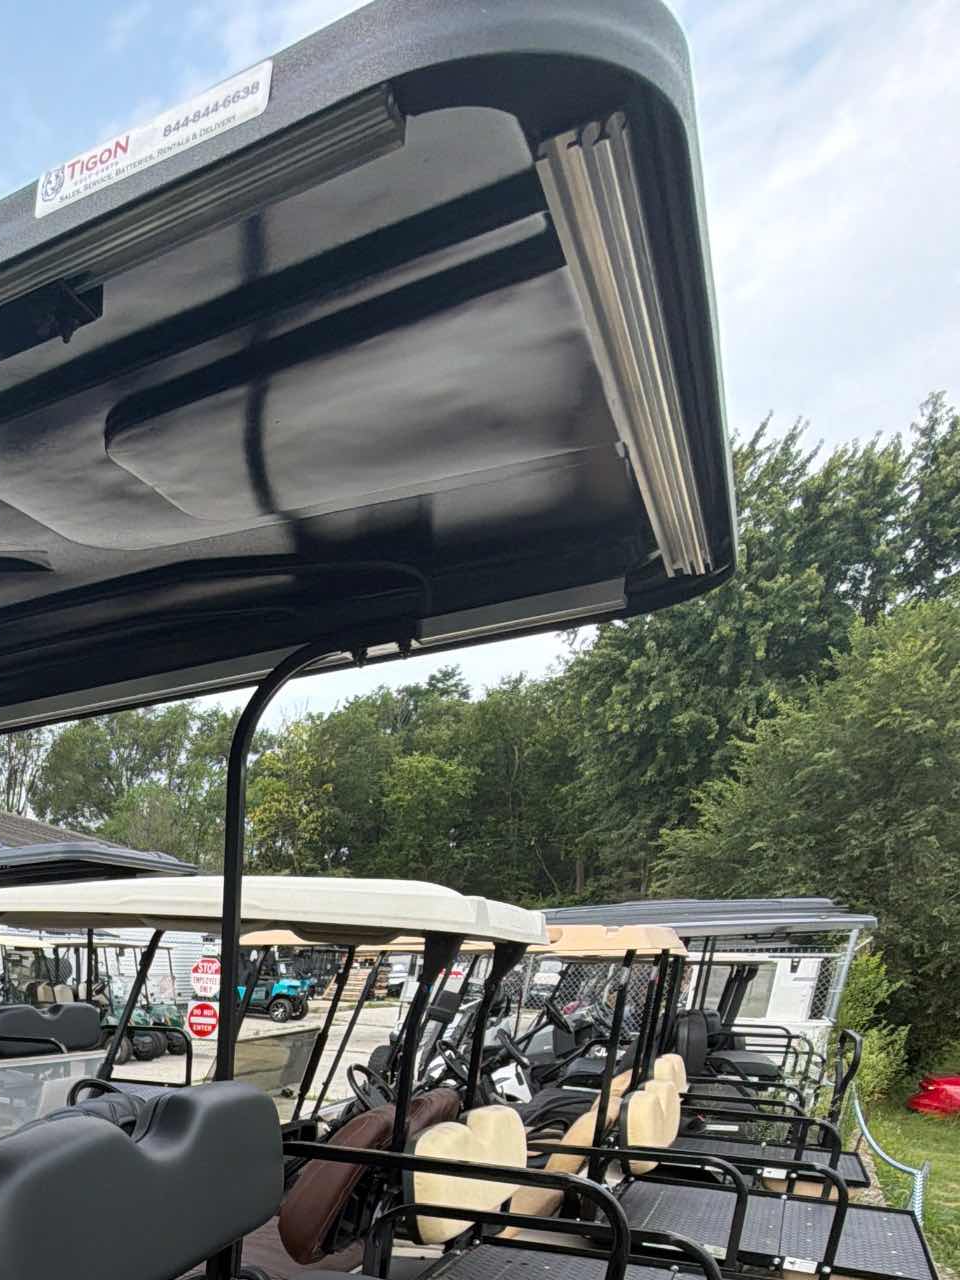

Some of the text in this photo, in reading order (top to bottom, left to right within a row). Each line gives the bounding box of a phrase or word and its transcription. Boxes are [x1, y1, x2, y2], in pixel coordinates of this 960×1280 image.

[162, 81, 260, 138] 844-844-6638
[67, 135, 130, 181] TIGON
[197, 962, 220, 975] STOP
